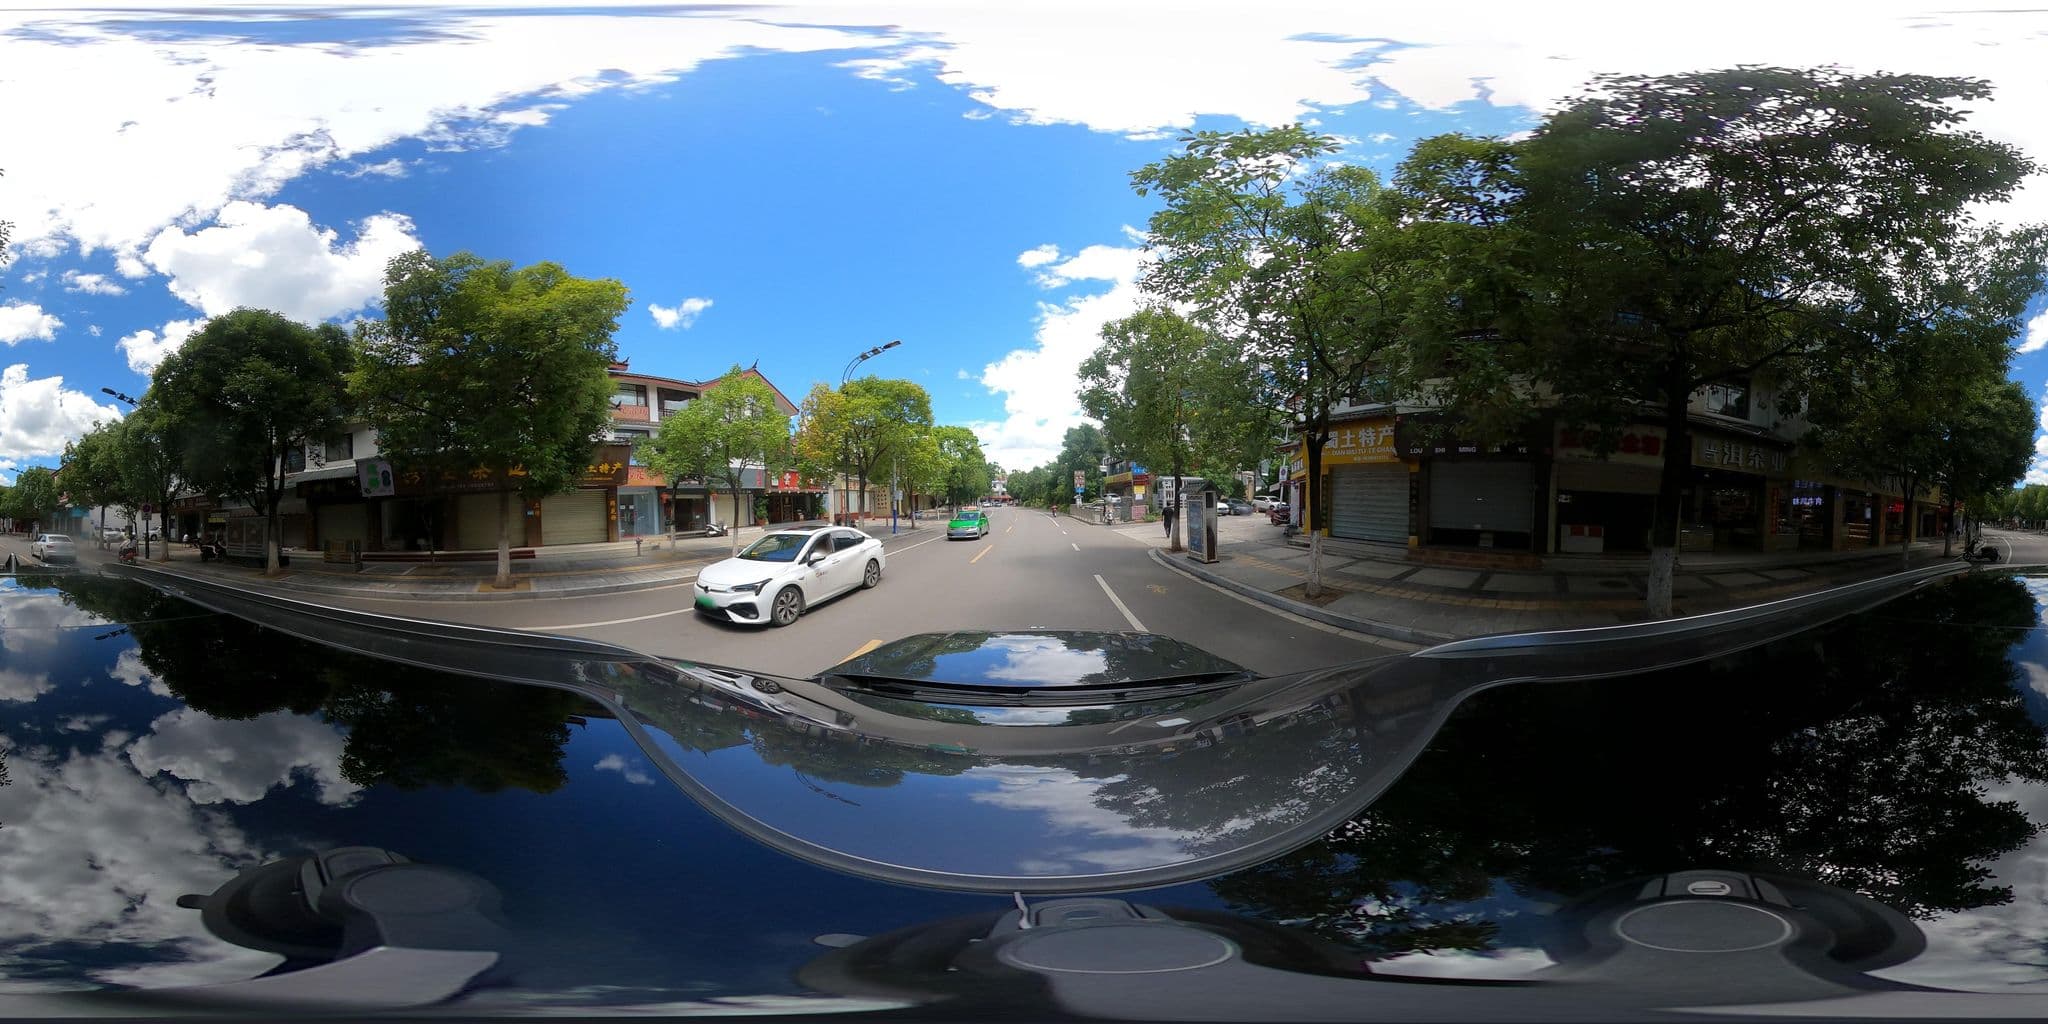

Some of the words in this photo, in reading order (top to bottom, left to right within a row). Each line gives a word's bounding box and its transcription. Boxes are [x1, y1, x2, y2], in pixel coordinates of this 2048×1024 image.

[1316, 425, 1394, 448] 蜀土特产
[584, 461, 623, 474] 土特产
